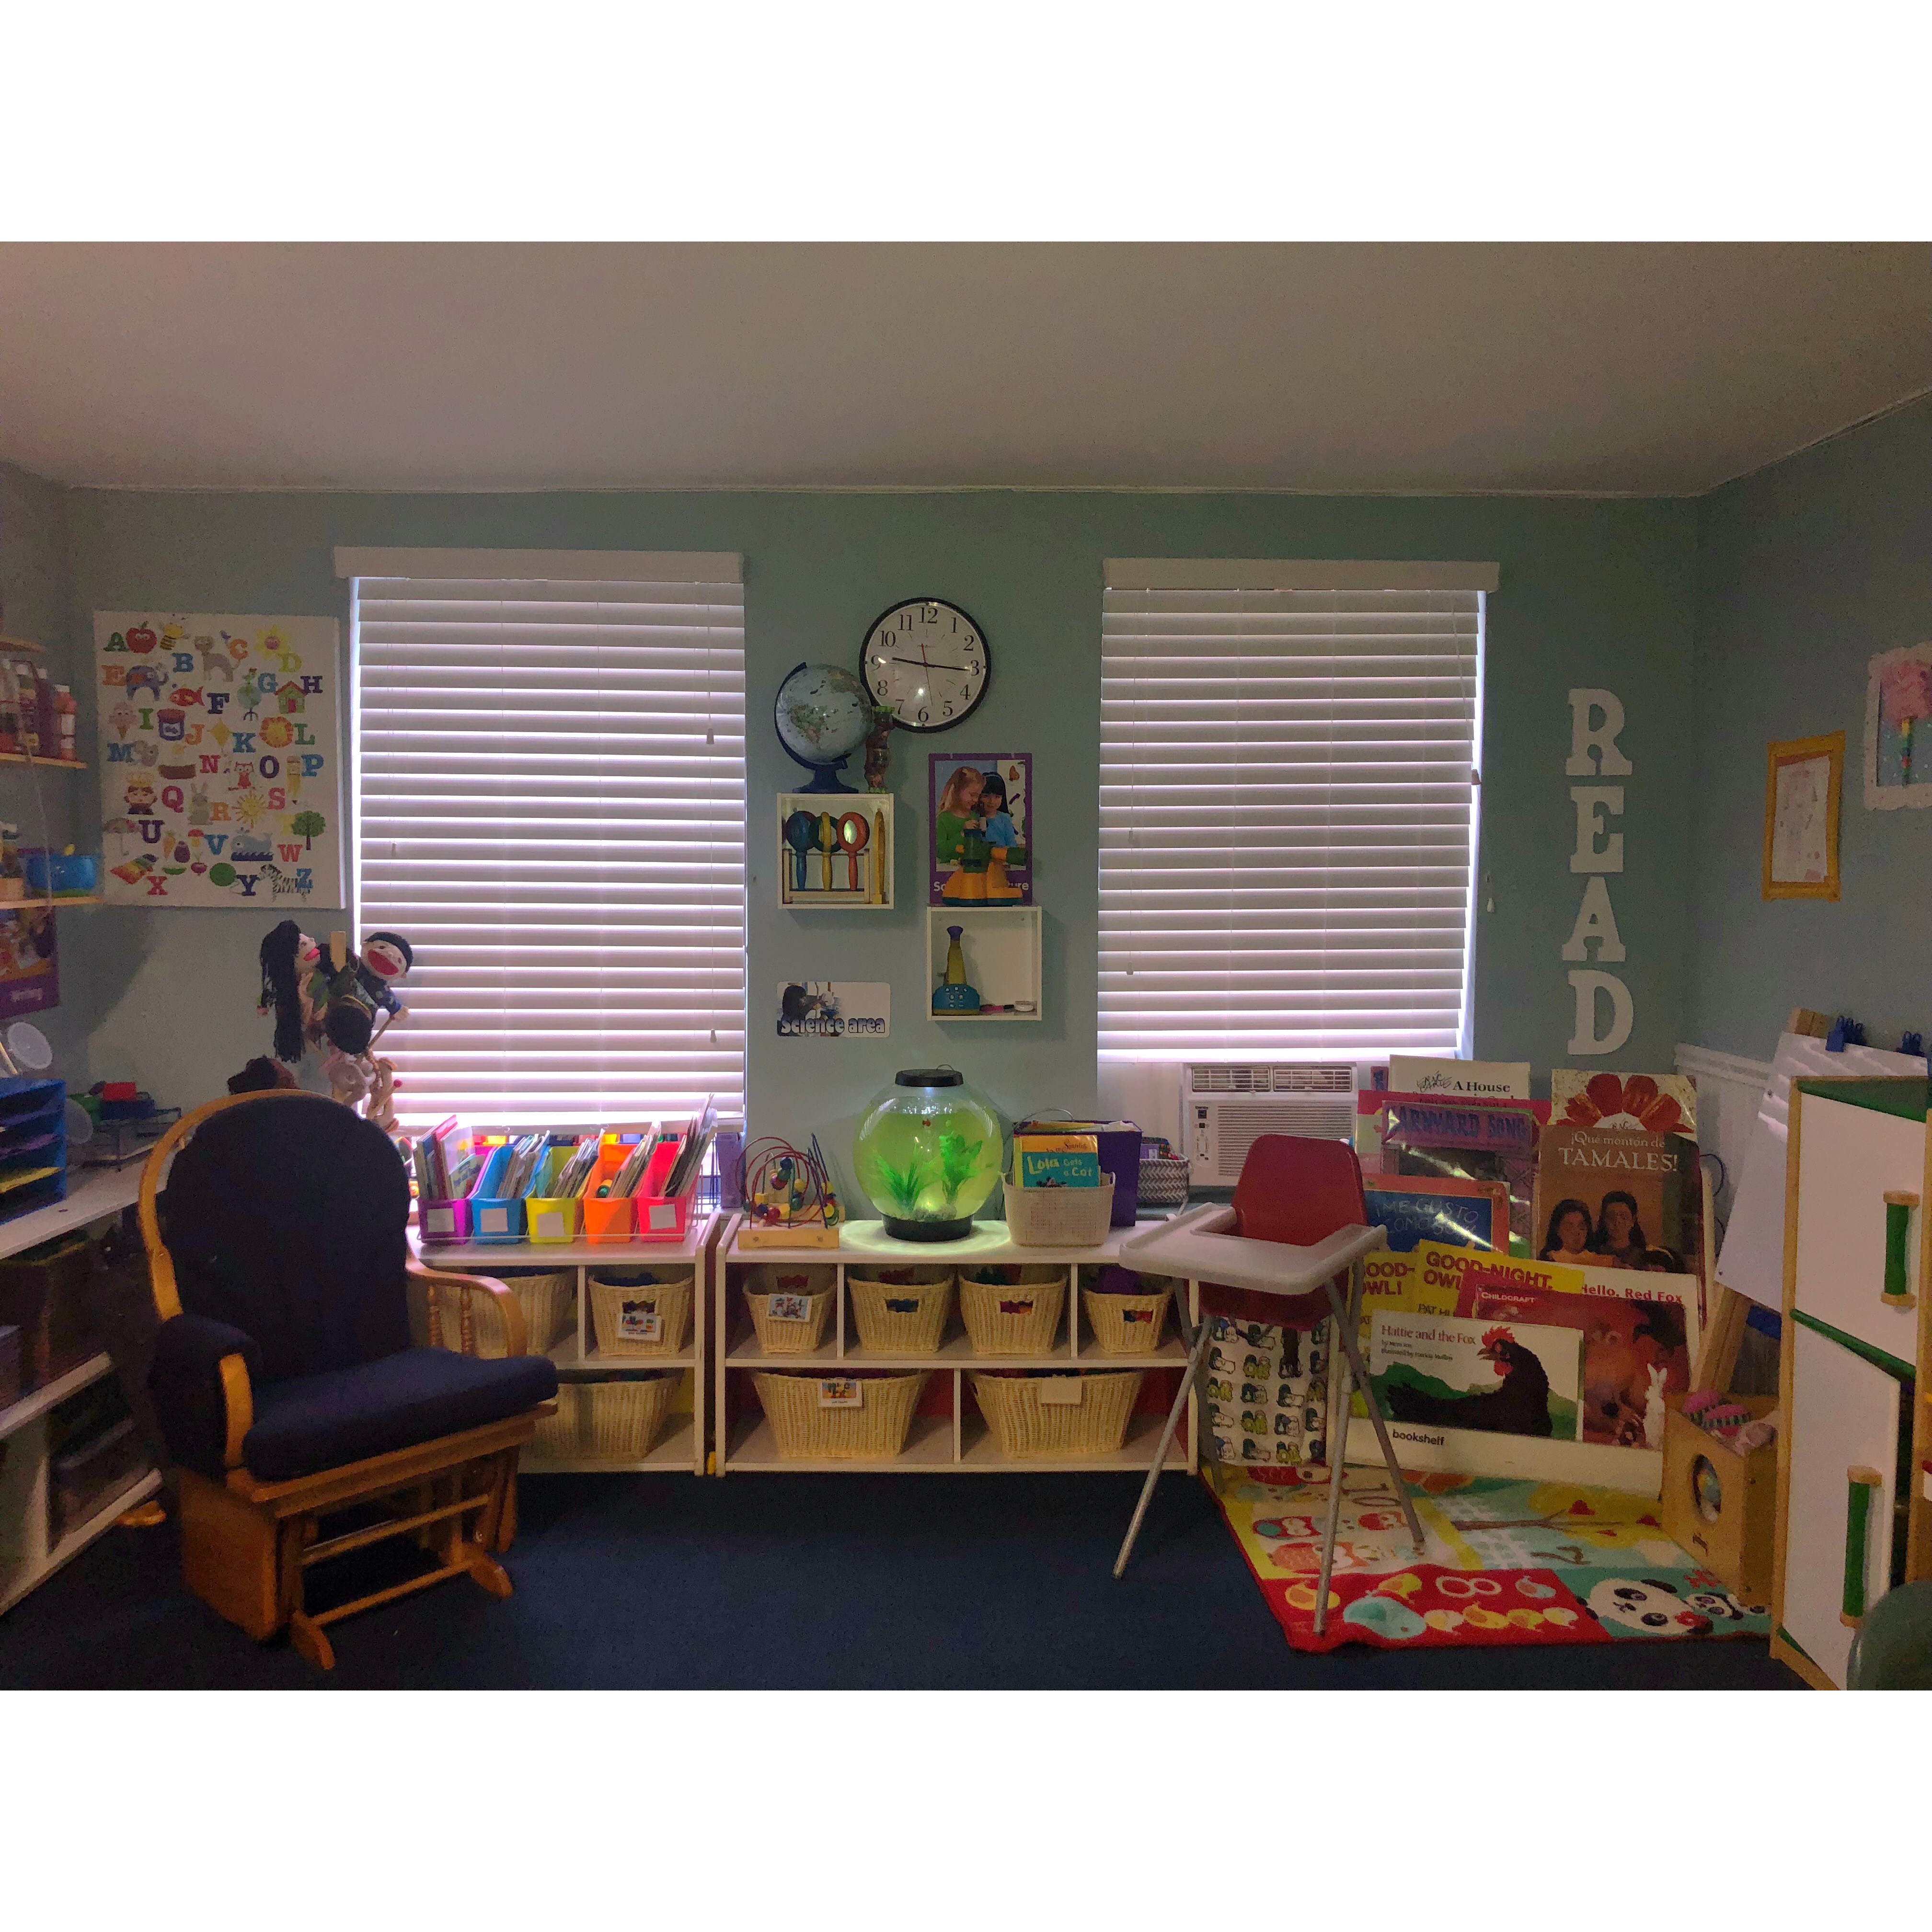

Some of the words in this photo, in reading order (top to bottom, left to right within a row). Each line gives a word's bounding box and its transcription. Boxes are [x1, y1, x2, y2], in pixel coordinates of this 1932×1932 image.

[897, 614, 913, 631] 11
[919, 607, 938, 624] 12
[951, 617, 957, 633] 1
[103, 632, 128, 652] A
[879, 631, 896, 646] 10
[964, 635, 974, 651] 2
[229, 639, 248, 659] C
[172, 653, 194, 672] B
[279, 653, 301, 672] D
[871, 655, 882, 670] 9
[969, 660, 980, 676] 3
[101, 665, 126, 685] E
[258, 673, 277, 693] G
[300, 676, 323, 693] H
[877, 680, 888, 696] 8
[960, 684, 971, 700] 4
[207, 693, 230, 714] F
[895, 699, 905, 714] 7
[943, 701, 953, 716] 5
[138, 708, 154, 729] I
[918, 706, 929, 722] 6
[184, 724, 205, 745] J
[233, 732, 256, 753] K
[295, 723, 315, 745] L
[107, 743, 135, 762] M
[199, 755, 220, 773] N
[260, 755, 279, 778] O
[301, 755, 324, 777] P
[162, 786, 184, 813] Q
[269, 788, 285, 810] S
[210, 803, 231, 821] R
[139, 820, 163, 843] U
[205, 835, 228, 855] V
[277, 844, 302, 862] W
[297, 868, 312, 888] Z
[1562, 689, 1634, 1055] READ
[148, 876, 168, 895] X
[237, 875, 259, 896] Y
[848, 1018, 885, 1034] area
[1453, 1081, 1464, 1091] A
[1466, 1081, 1510, 1092] House
[1571, 1131, 1601, 1146] ¡Qué
[1651, 1136, 1666, 1148] de
[1027, 1156, 1060, 1174] Lola
[1558, 1148, 1678, 1172] TAMALES!
[1072, 1167, 1092, 1177] Cat
[1481, 1292, 1535, 1303] CHILDCRAFT
[1625, 1288, 1651, 1300] Red
[1657, 1292, 1683, 1304] Fox
[1415, 1329, 1436, 1340] and
[1438, 1330, 1455, 1342] the
[1457, 1333, 1477, 1345] Fox
[1392, 1428, 1445, 1445] bookshelf
